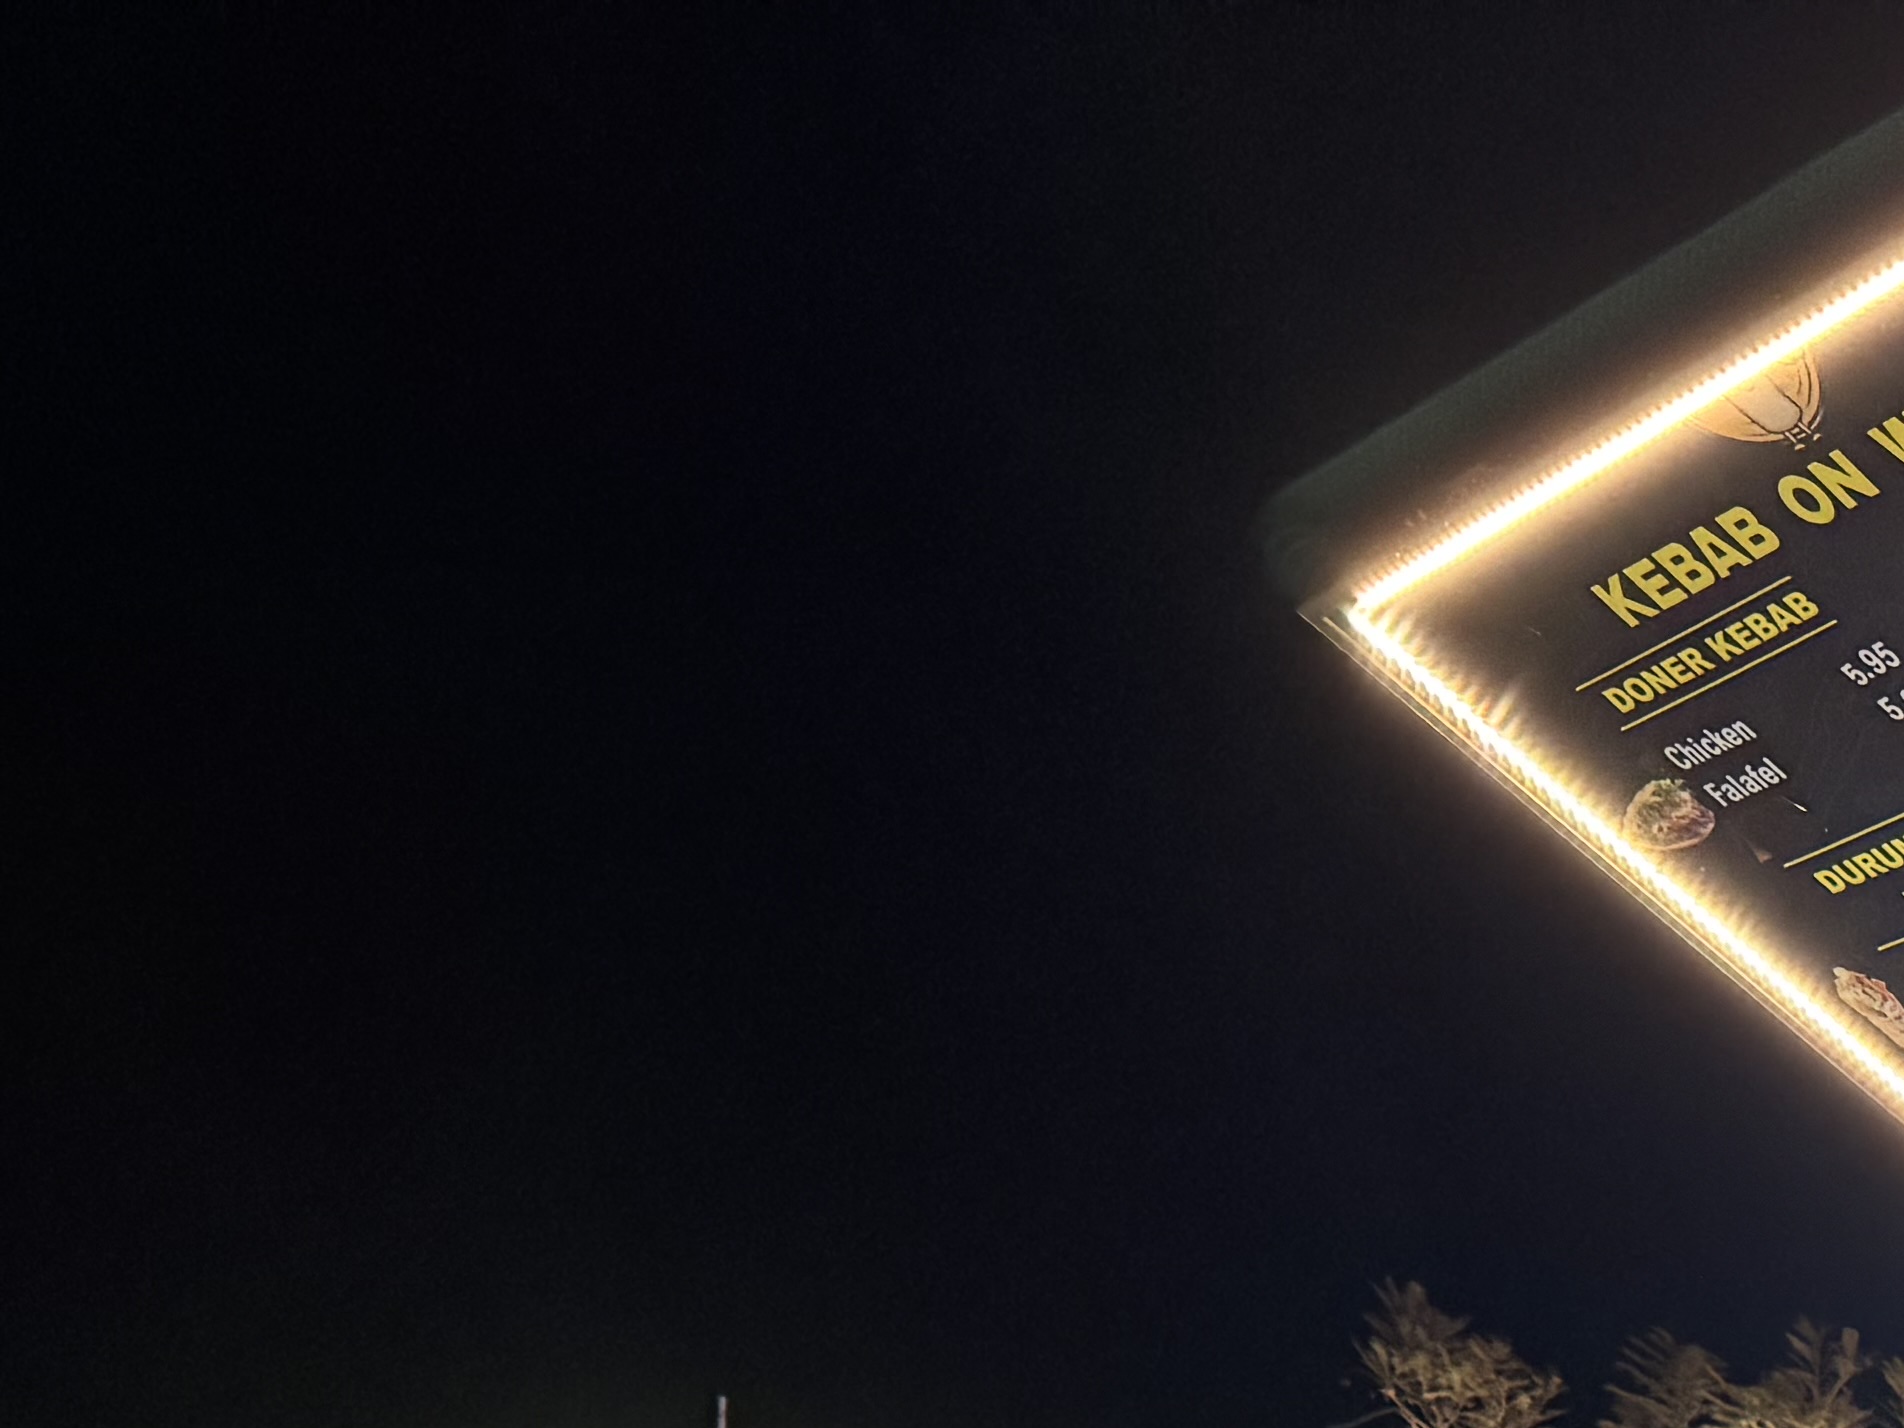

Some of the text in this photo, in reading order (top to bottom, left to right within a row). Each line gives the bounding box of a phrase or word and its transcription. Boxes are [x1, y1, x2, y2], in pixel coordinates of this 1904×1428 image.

[1590, 506, 1780, 628] KEBAB
[1777, 449, 1880, 524] ON
[1601, 591, 1819, 714] DONER KEBAB
[1840, 641, 1901, 687] 5.95
[1664, 719, 1757, 770] Chicken
[1703, 757, 1787, 808] Falafel
